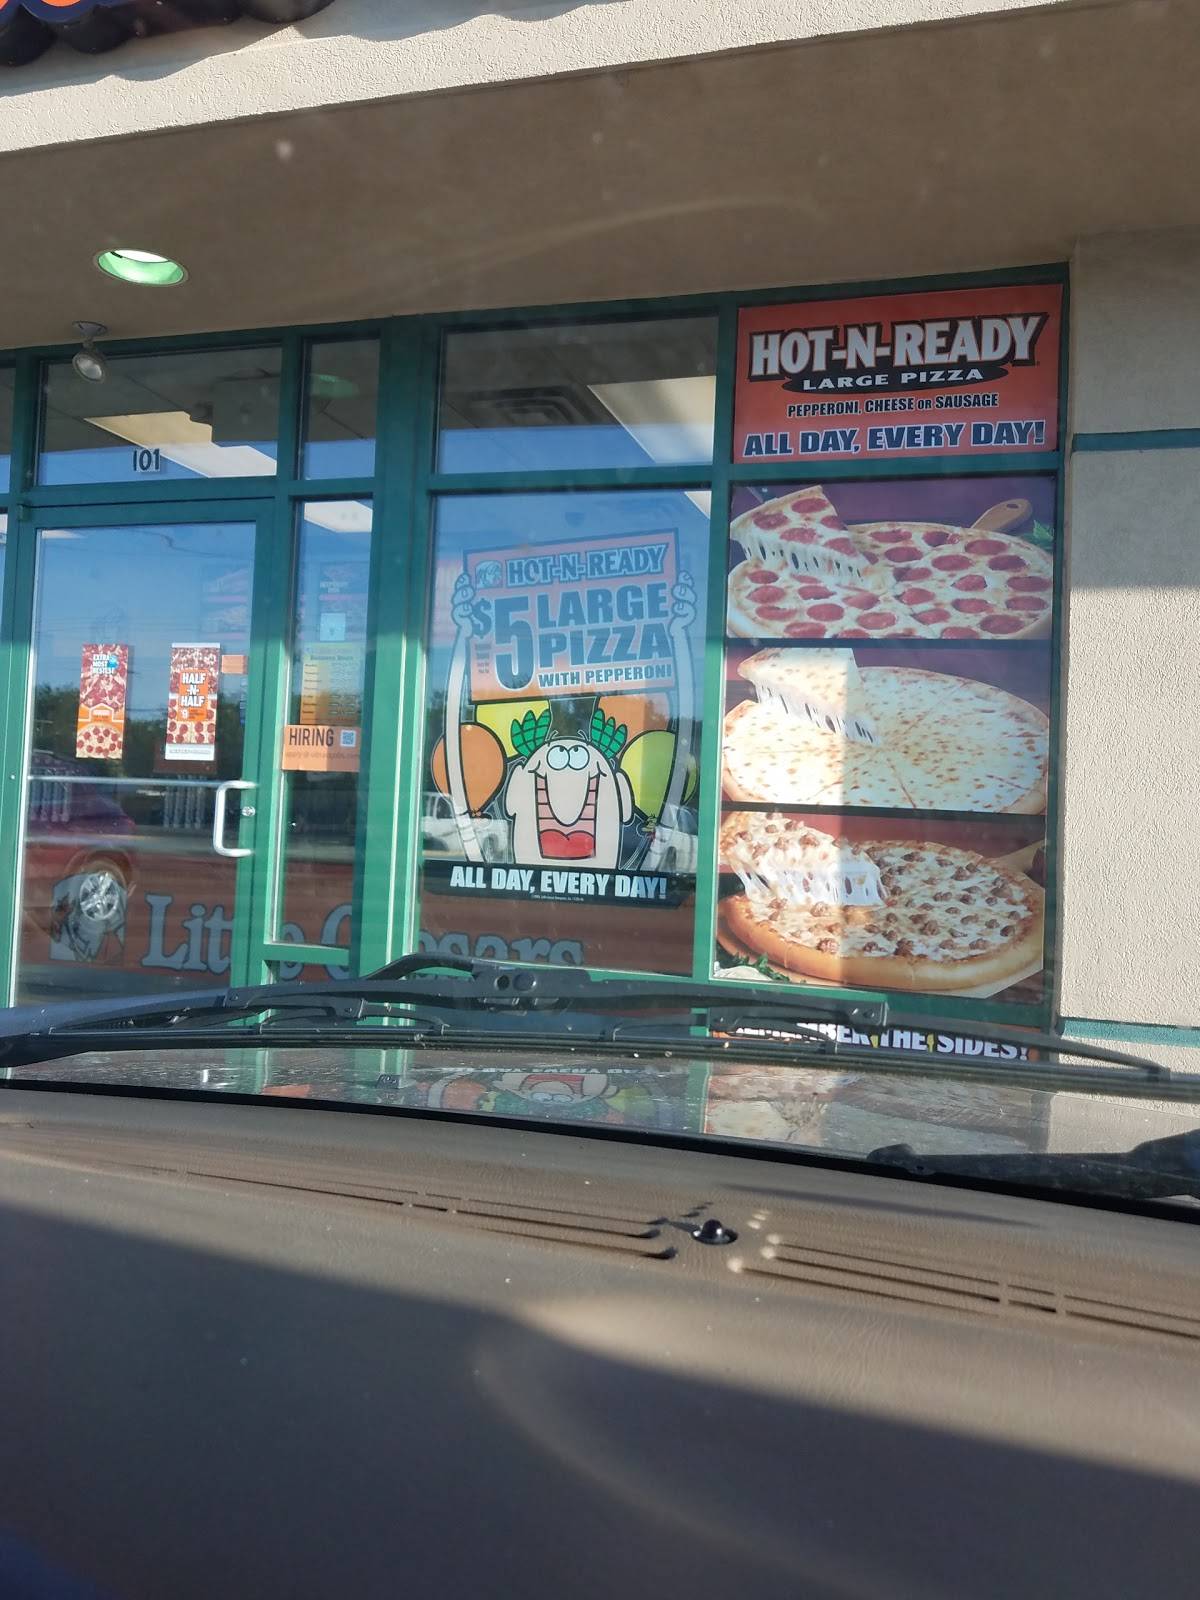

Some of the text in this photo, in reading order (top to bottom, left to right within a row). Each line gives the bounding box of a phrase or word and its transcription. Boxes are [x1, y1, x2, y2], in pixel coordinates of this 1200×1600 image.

[750, 314, 1044, 377] HOT-N-READY
[803, 367, 984, 391] LARGE PIZZA
[787, 400, 862, 418] PEPPERONI,
[864, 397, 914, 413] CHEESE
[935, 393, 999, 409] SAUSAGE
[743, 420, 1046, 457] ALL DAY, EVERY DAY!
[132, 447, 160, 472] 101
[506, 545, 668, 587] HOT-N-READY
[536, 582, 669, 629] LARGE
[538, 622, 672, 669] PIZZA
[182, 672, 206, 684] HALF
[538, 663, 672, 688] WITH PEPPERONI
[180, 695, 205, 707] HALF
[289, 728, 334, 747] HIRING
[450, 865, 668, 900] ALL DAY, EVERY DAY!
